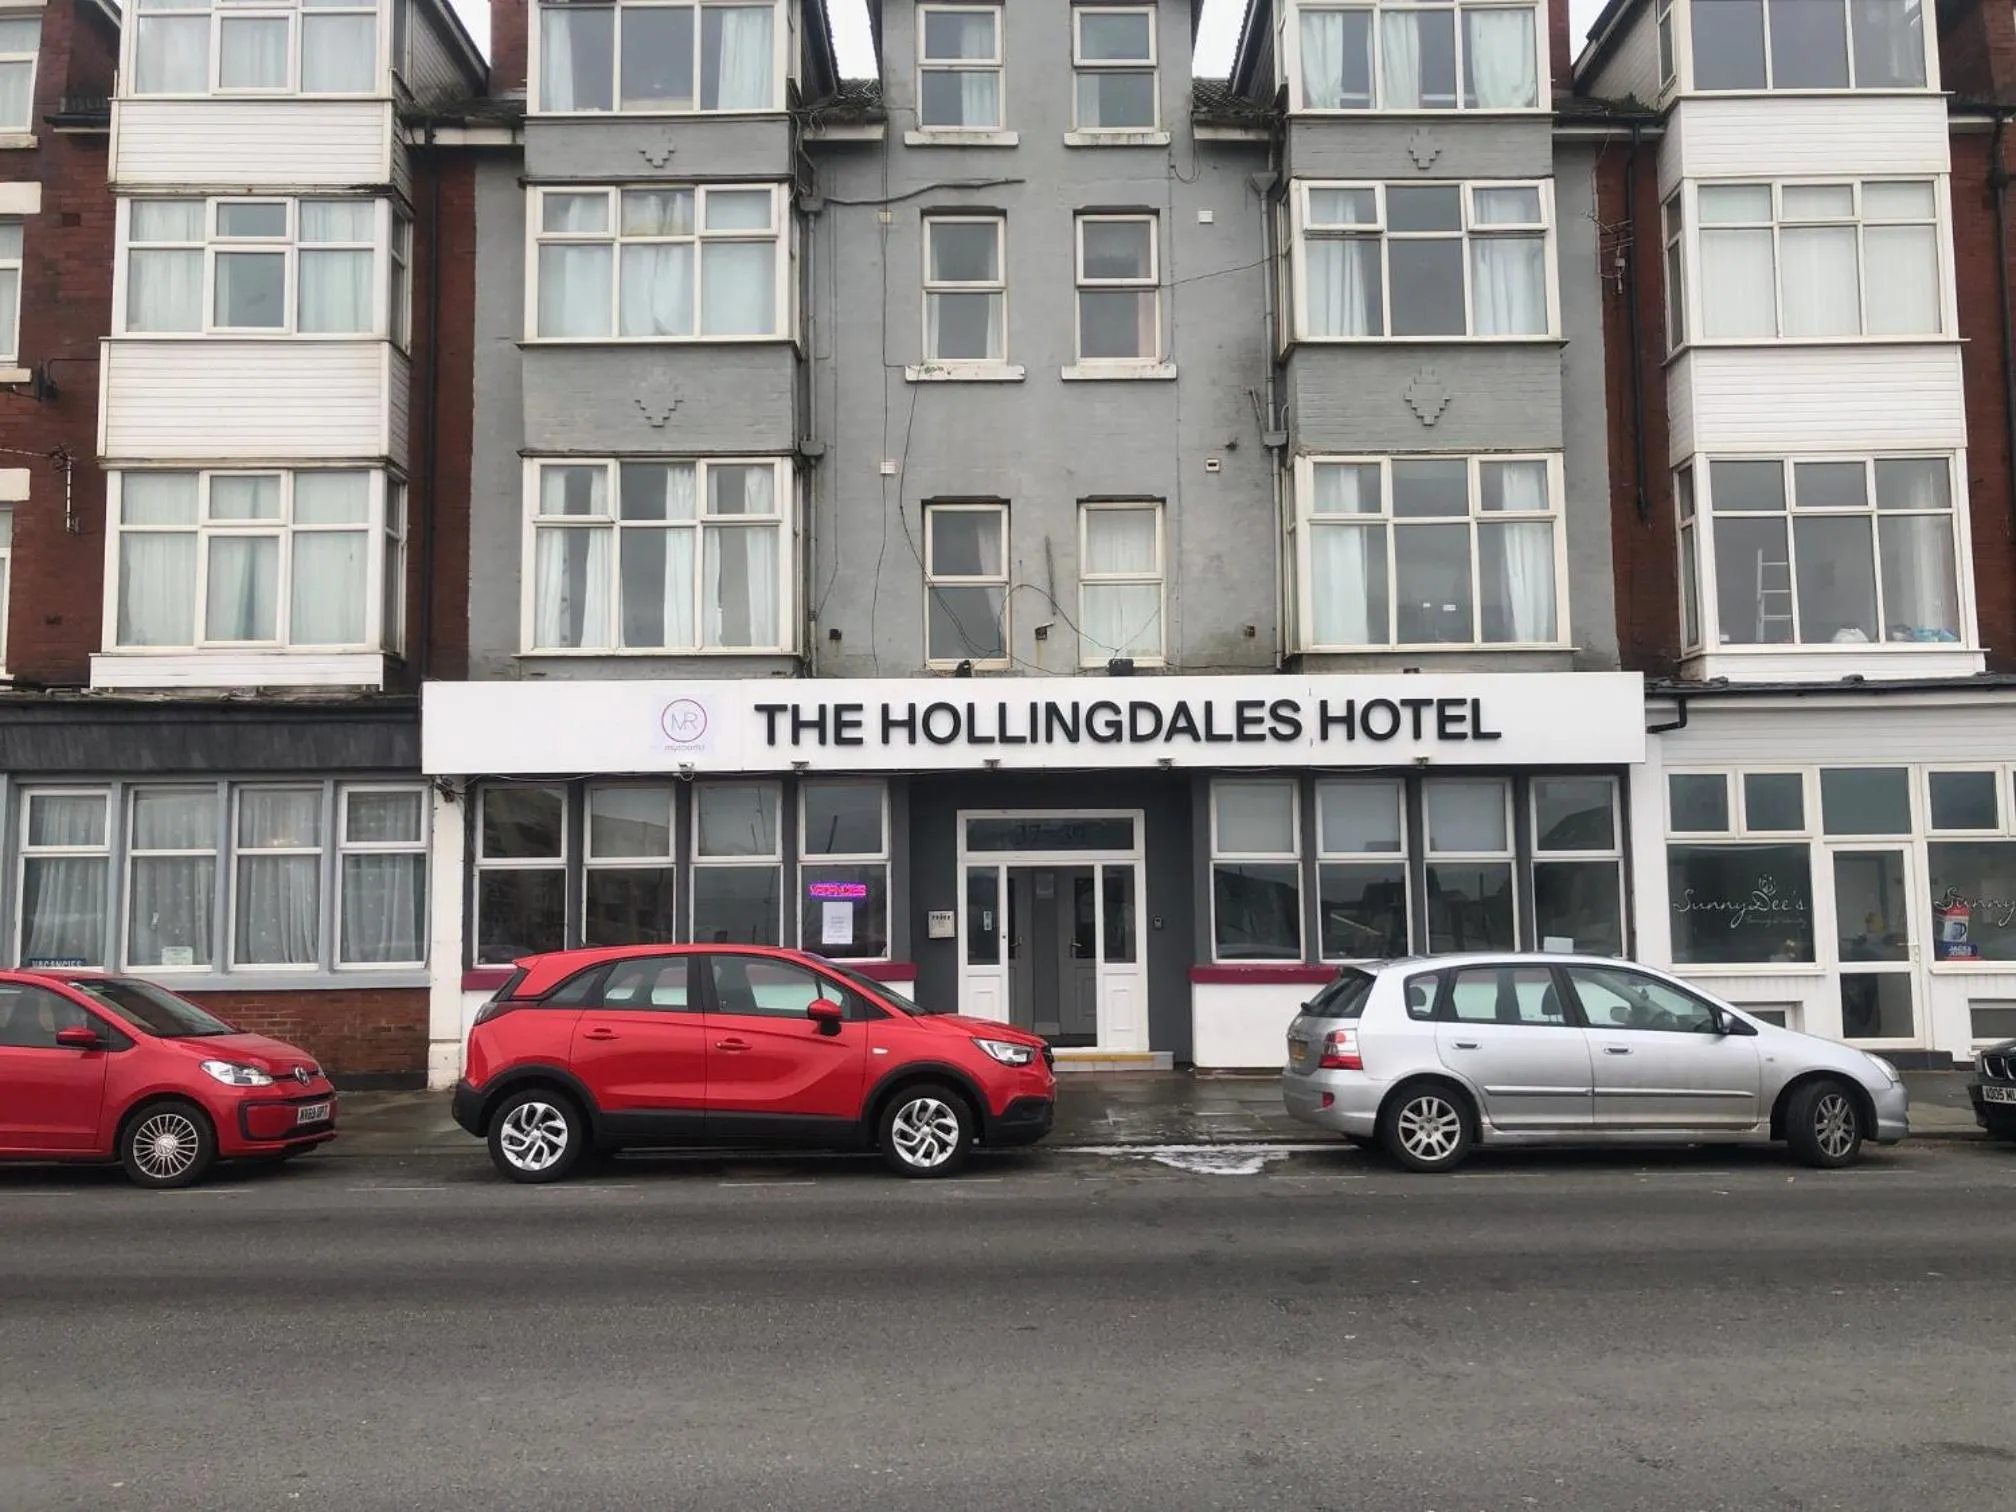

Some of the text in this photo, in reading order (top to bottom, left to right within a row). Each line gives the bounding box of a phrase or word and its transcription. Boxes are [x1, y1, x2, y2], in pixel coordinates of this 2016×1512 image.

[670, 711, 698, 731] MR
[754, 698, 1501, 746] THE HOLLINGDALES HOTEL
